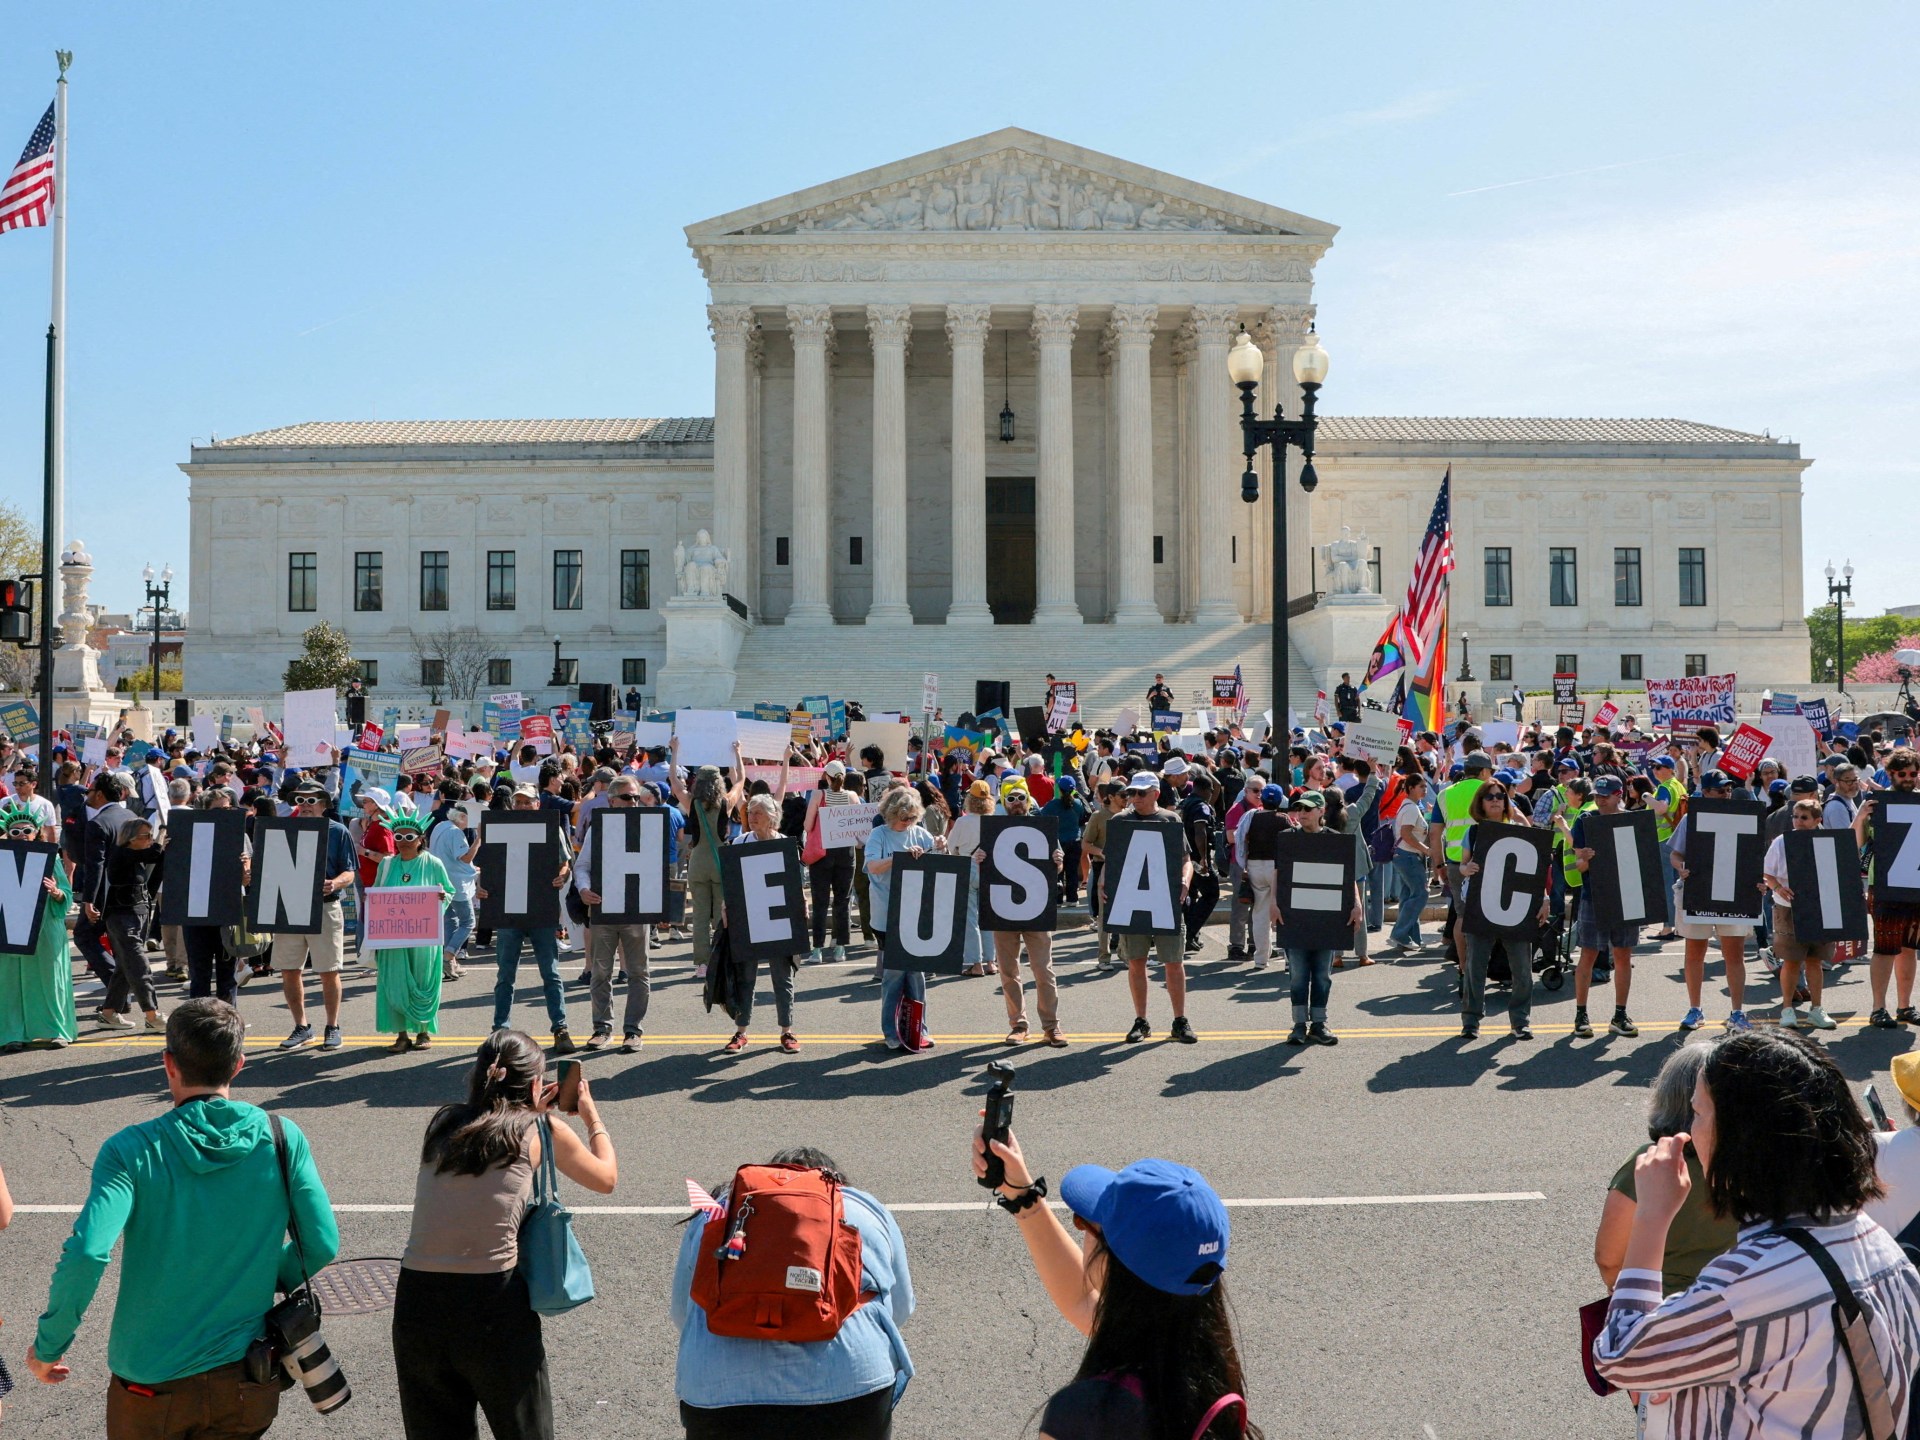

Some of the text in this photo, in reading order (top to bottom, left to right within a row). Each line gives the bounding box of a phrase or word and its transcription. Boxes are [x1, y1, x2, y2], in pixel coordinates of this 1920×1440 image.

[1735, 733, 1765, 755] BIRTH
[1728, 743, 1759, 764] RIGHT
[828, 808, 861, 819] NACIDO
[388, 908, 406, 916] IS A
[368, 917, 431, 935] BIRTHRIGHT
[1198, 1241, 1219, 1255] ACLU
[790, 1272, 809, 1280] NORTH
